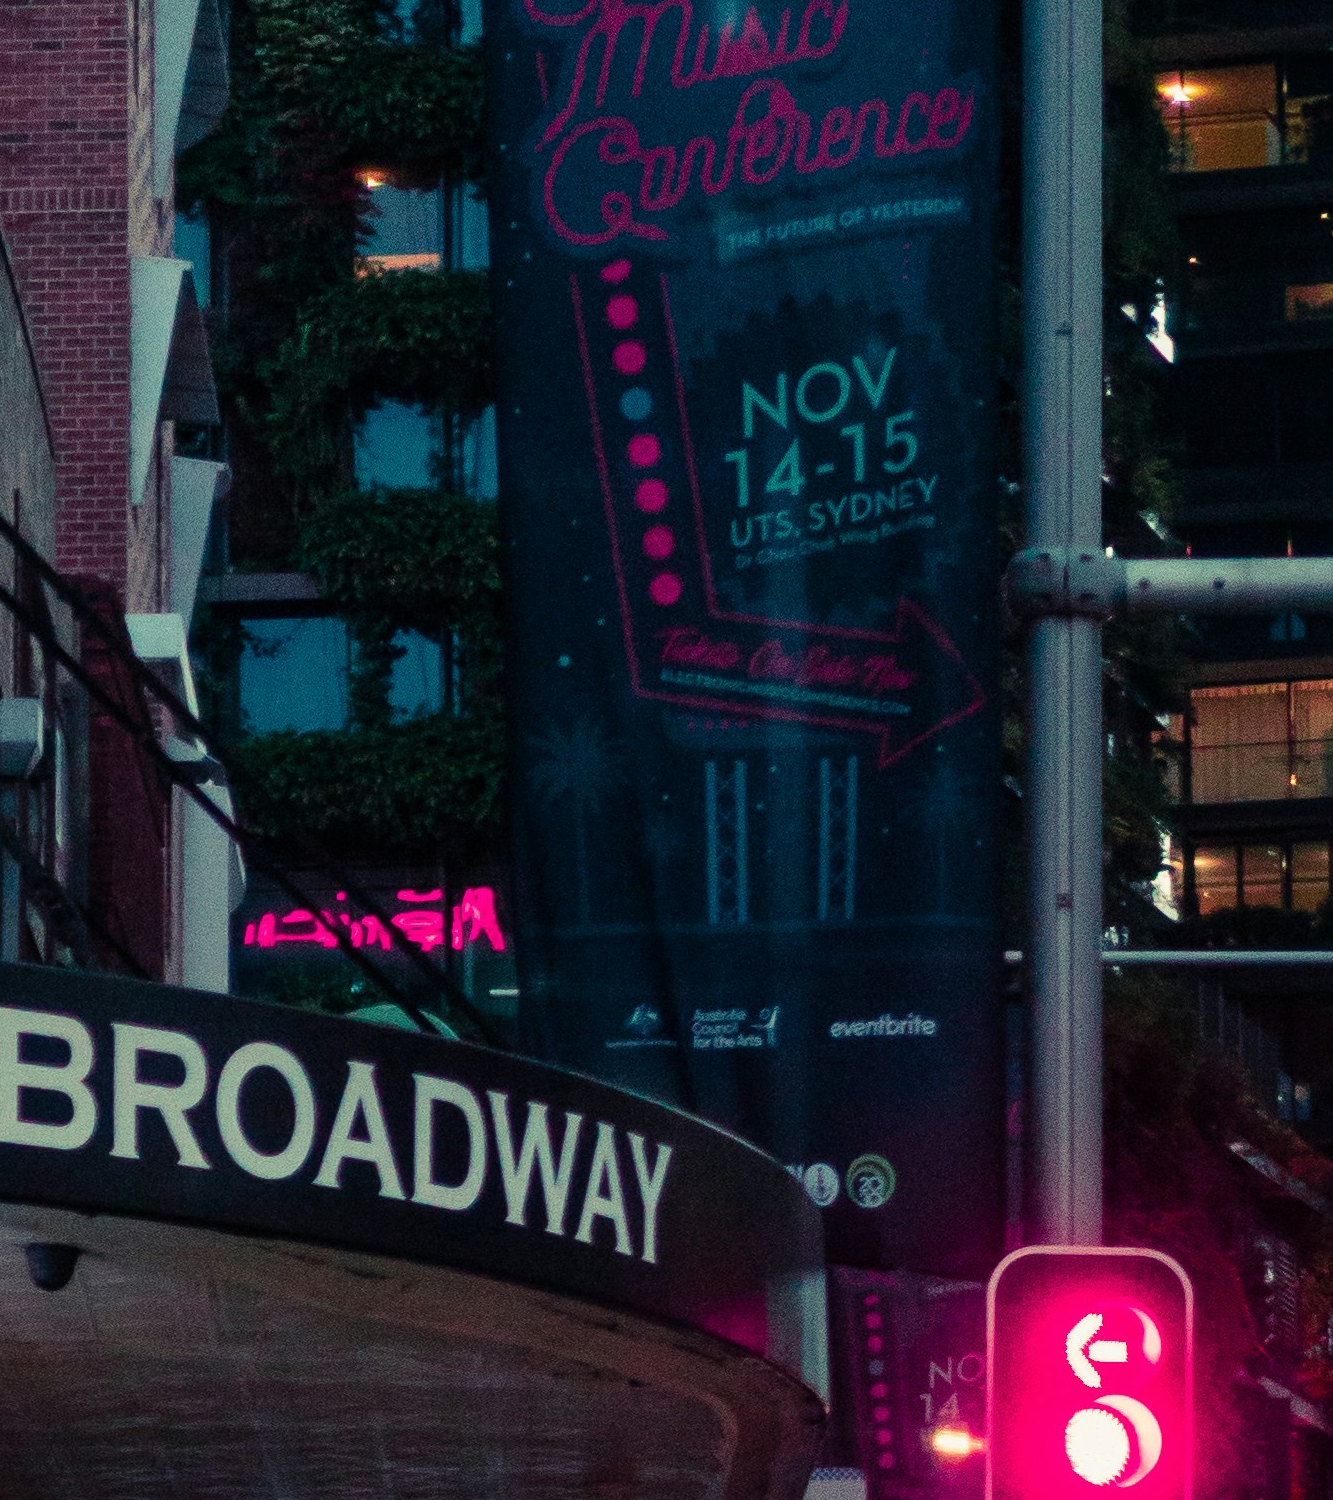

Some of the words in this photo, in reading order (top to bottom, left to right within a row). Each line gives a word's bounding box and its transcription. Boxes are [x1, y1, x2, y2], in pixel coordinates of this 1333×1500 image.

[544, 78, 975, 246] Conference
[726, 223, 763, 250] THE
[766, 213, 836, 244] FUTURE
[841, 207, 865, 230] OF
[870, 196, 967, 223] YESTERDAY
[742, 347, 897, 438] NOV
[725, 409, 917, 507] 14-15
[808, 474, 938, 531] SYDNEY
[830, 1012, 936, 1038] eventbrite
[928, 1354, 985, 1389] NO
